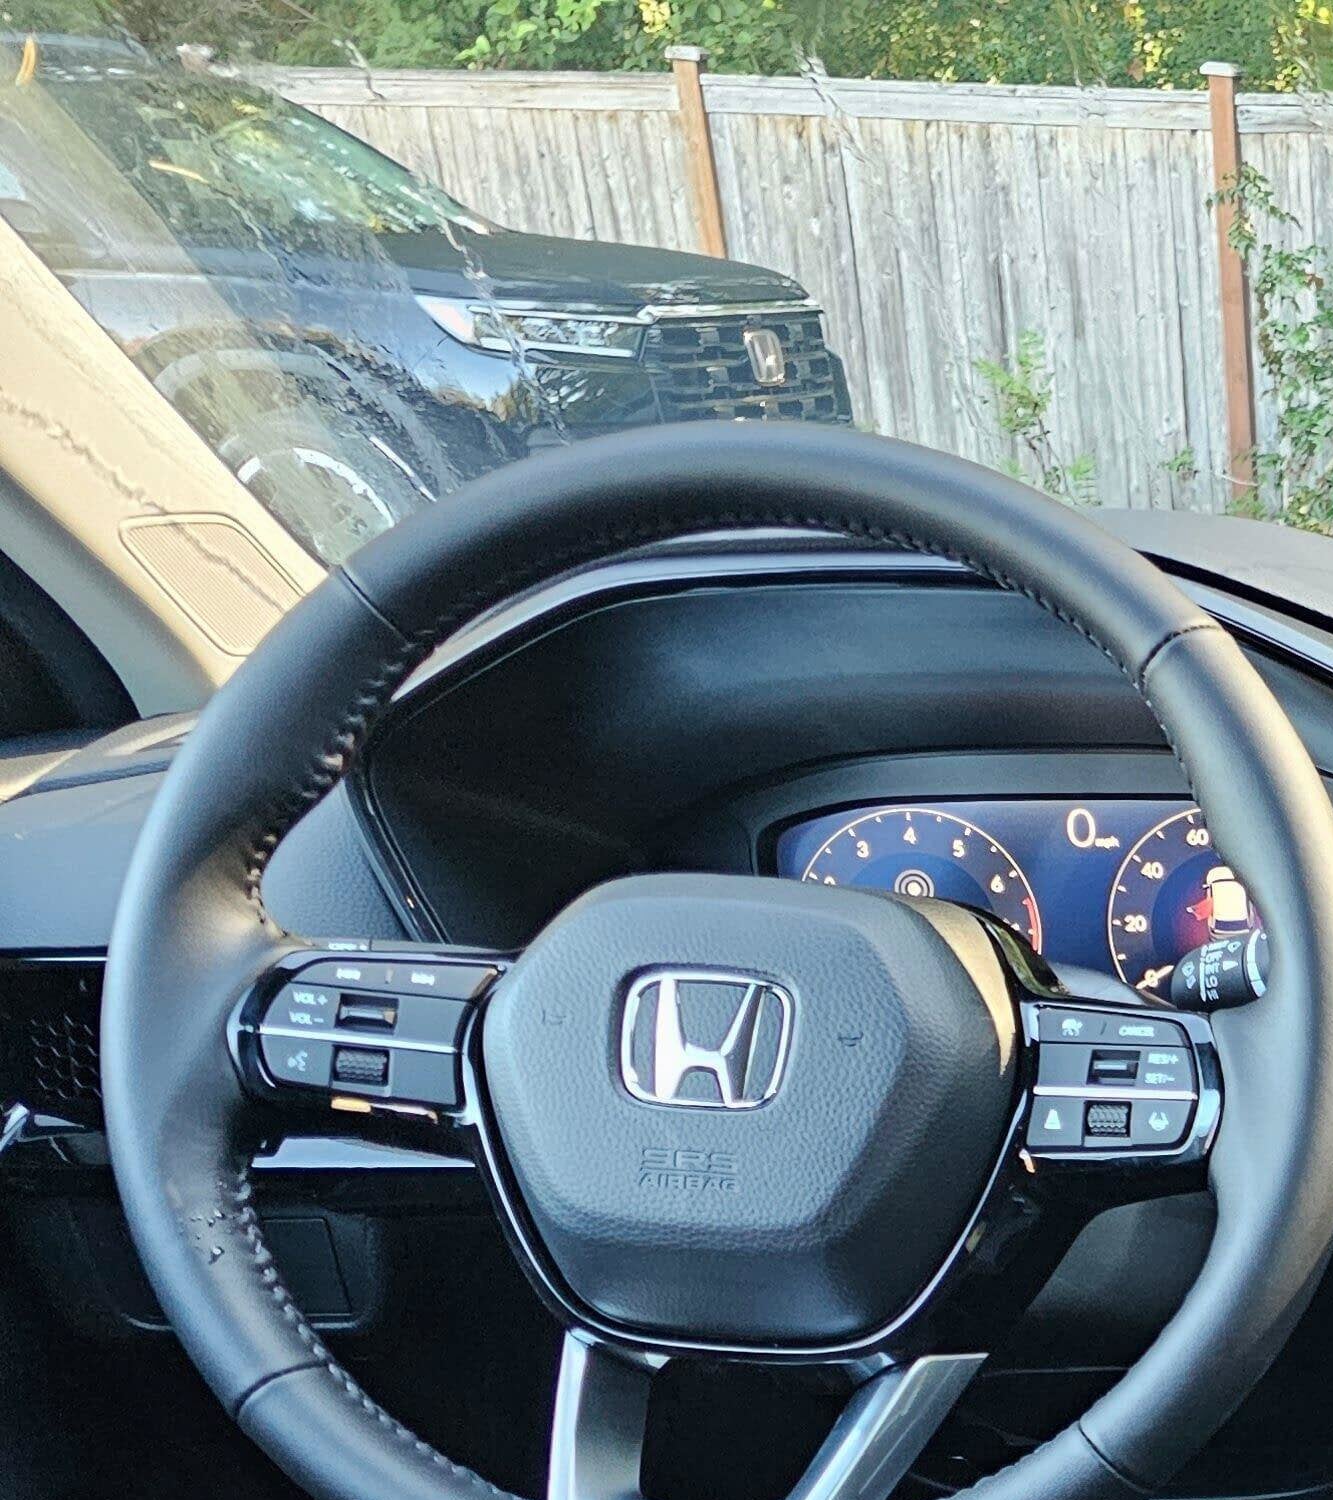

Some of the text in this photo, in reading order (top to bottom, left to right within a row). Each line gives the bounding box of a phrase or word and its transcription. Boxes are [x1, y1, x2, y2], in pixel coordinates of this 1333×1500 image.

[903, 826, 918, 845] 4
[1066, 808, 1096, 848] 0
[1186, 829, 1209, 846] 60
[856, 840, 870, 858] 3
[952, 839, 966, 858] 5
[1140, 862, 1164, 879] 40
[990, 874, 1006, 893] 6
[1124, 915, 1148, 933] 20
[640, 1147, 738, 1176] SRS
[639, 1172, 740, 1192] AIRBAG
